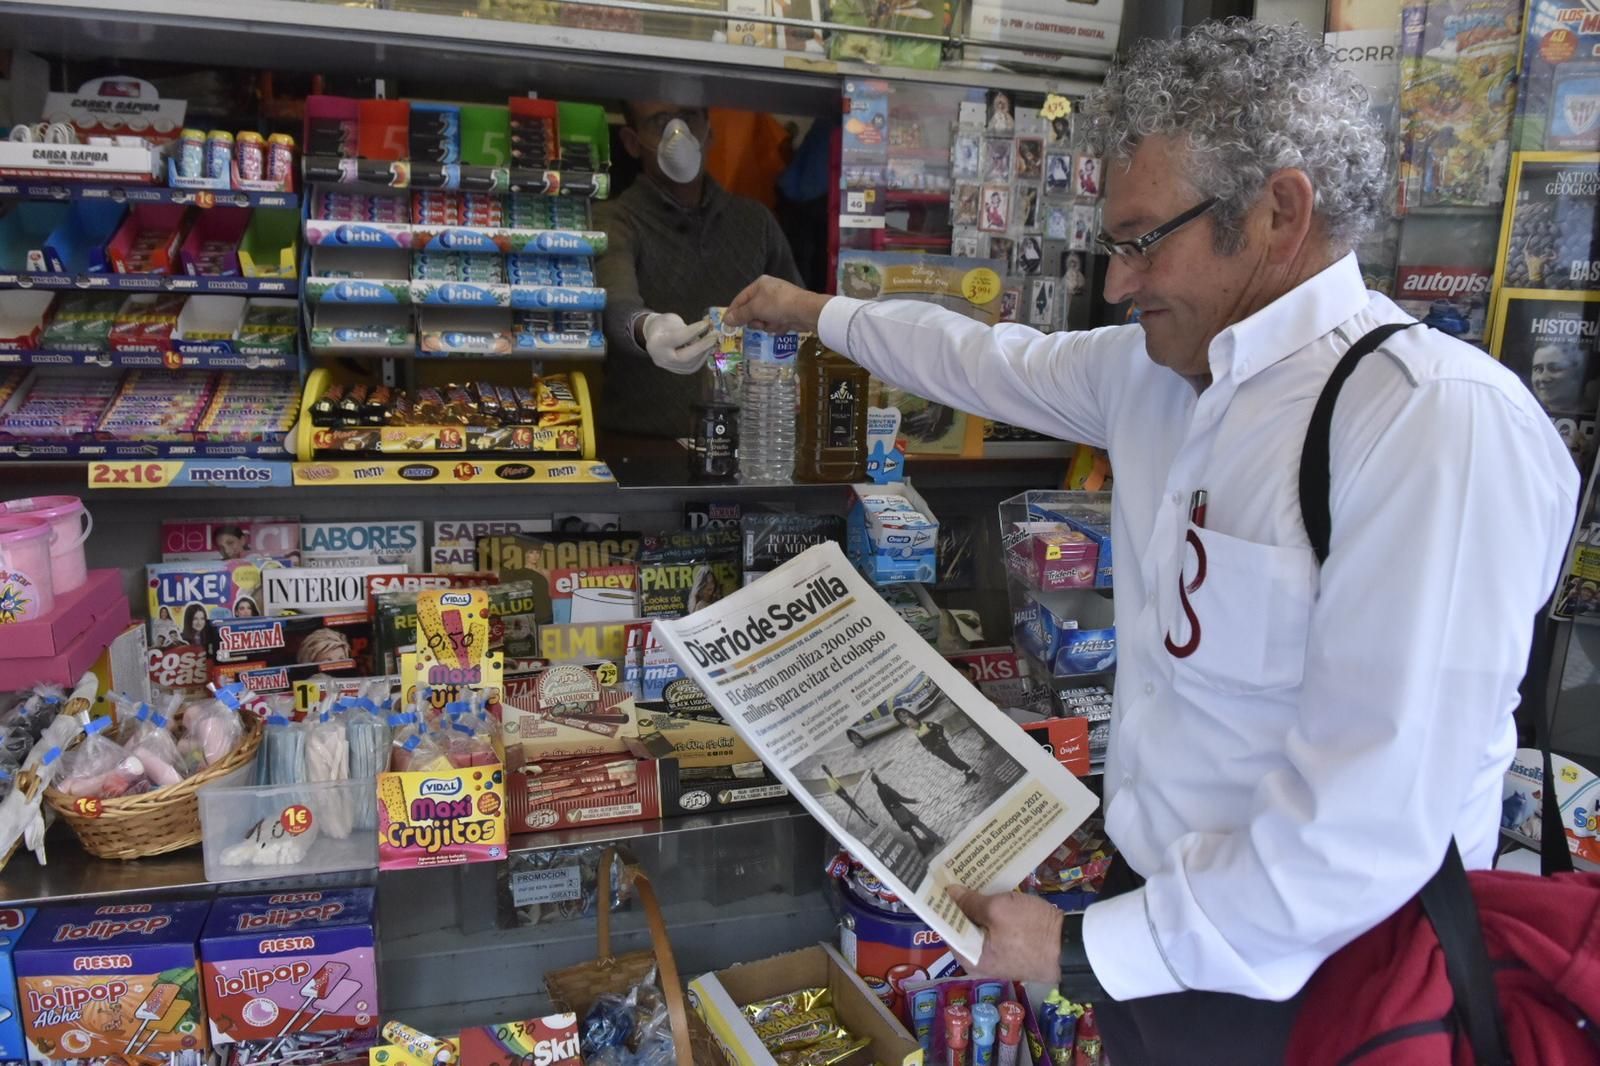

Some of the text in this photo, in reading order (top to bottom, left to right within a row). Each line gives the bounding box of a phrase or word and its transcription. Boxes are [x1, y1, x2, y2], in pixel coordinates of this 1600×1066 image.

[1009, 19, 1023, 28] PIN
[1034, 22, 1076, 35] CONTENIDO
[1077, 27, 1105, 39] DIGITAL
[32, 149, 109, 162] CARGA RÁPIDA
[850, 201, 862, 209] 4G
[208, 281, 248, 289] mentos
[336, 282, 380, 300] Orbit
[440, 284, 482, 302] Orbit
[446, 332, 486, 346] Orbit
[318, 432, 332, 444] 1€
[444, 431, 459, 442] 1€
[516, 429, 530, 442] 1€
[562, 435, 576, 446] 1€
[92, 464, 163, 483] 2x1€
[190, 467, 272, 482] mentos
[457, 463, 471, 476] 1€
[302, 525, 417, 551] LABORES
[445, 596, 470, 605] VIDAL
[684, 575, 849, 669] Diario de Sevilla
[219, 623, 286, 651] SEMANA
[427, 632, 474, 652] 0,50
[1072, 639, 1115, 654] HALLS
[725, 691, 737, 706] El
[737, 673, 778, 700] Gobierno
[776, 653, 822, 684] moviliza
[820, 615, 873, 657] 200.000
[236, 668, 286, 691] SEMANA
[429, 665, 482, 685] Maxi
[742, 703, 779, 724] millones
[777, 690, 801, 713] para
[798, 665, 829, 695] evitar
[828, 657, 842, 673] el
[840, 630, 886, 667] colapso
[425, 781, 457, 793] VIDAL
[79, 798, 97, 812] 1€
[411, 797, 473, 821] Maxi
[285, 808, 306, 826] 1€
[387, 819, 497, 854] Crujitos
[953, 845, 985, 877] Aplazada
[984, 836, 992, 848] la
[990, 810, 1023, 840] Eurocopa
[976, 853, 991, 871] que
[990, 823, 1023, 857] concluyan
[1021, 812, 1034, 828] las
[517, 872, 567, 881] PROMOCION
[269, 891, 322, 905] FIESTA
[96, 904, 152, 916] FIESTA
[237, 902, 344, 932] lolipop
[53, 914, 172, 944] lolipop
[259, 935, 316, 953] FIESTA
[74, 955, 133, 971] FIESTA
[214, 961, 312, 997] lolipop
[28, 980, 129, 1013] lolipop
[33, 1008, 83, 1029] Aloha
[496, 1022, 536, 1042] 0,70
